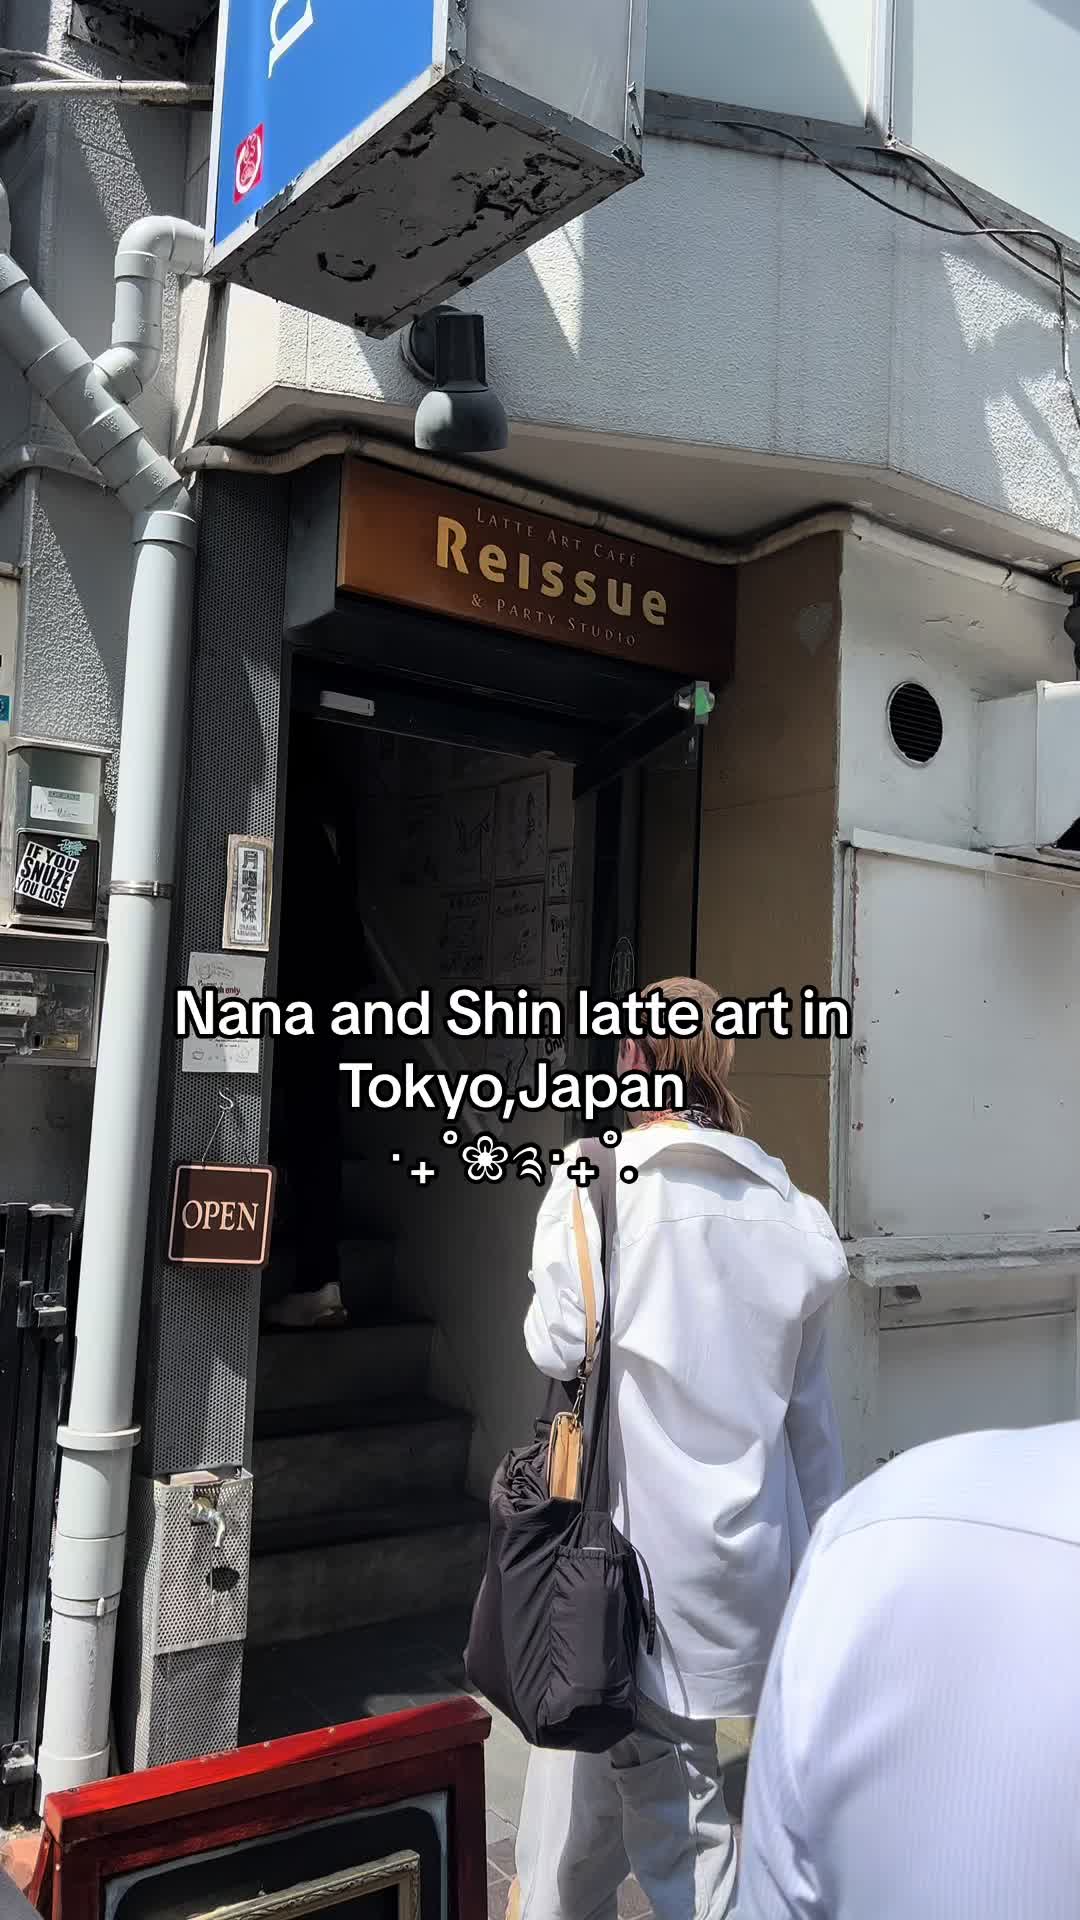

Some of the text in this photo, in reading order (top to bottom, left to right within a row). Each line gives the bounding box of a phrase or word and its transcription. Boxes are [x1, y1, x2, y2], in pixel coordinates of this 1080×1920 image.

[471, 593, 484, 608] &
[26, 843, 42, 859] IF
[45, 848, 77, 872] YOU
[21, 856, 73, 893] SNUZE
[17, 876, 66, 908] YOU LOSE
[181, 1199, 259, 1231] OPEN
